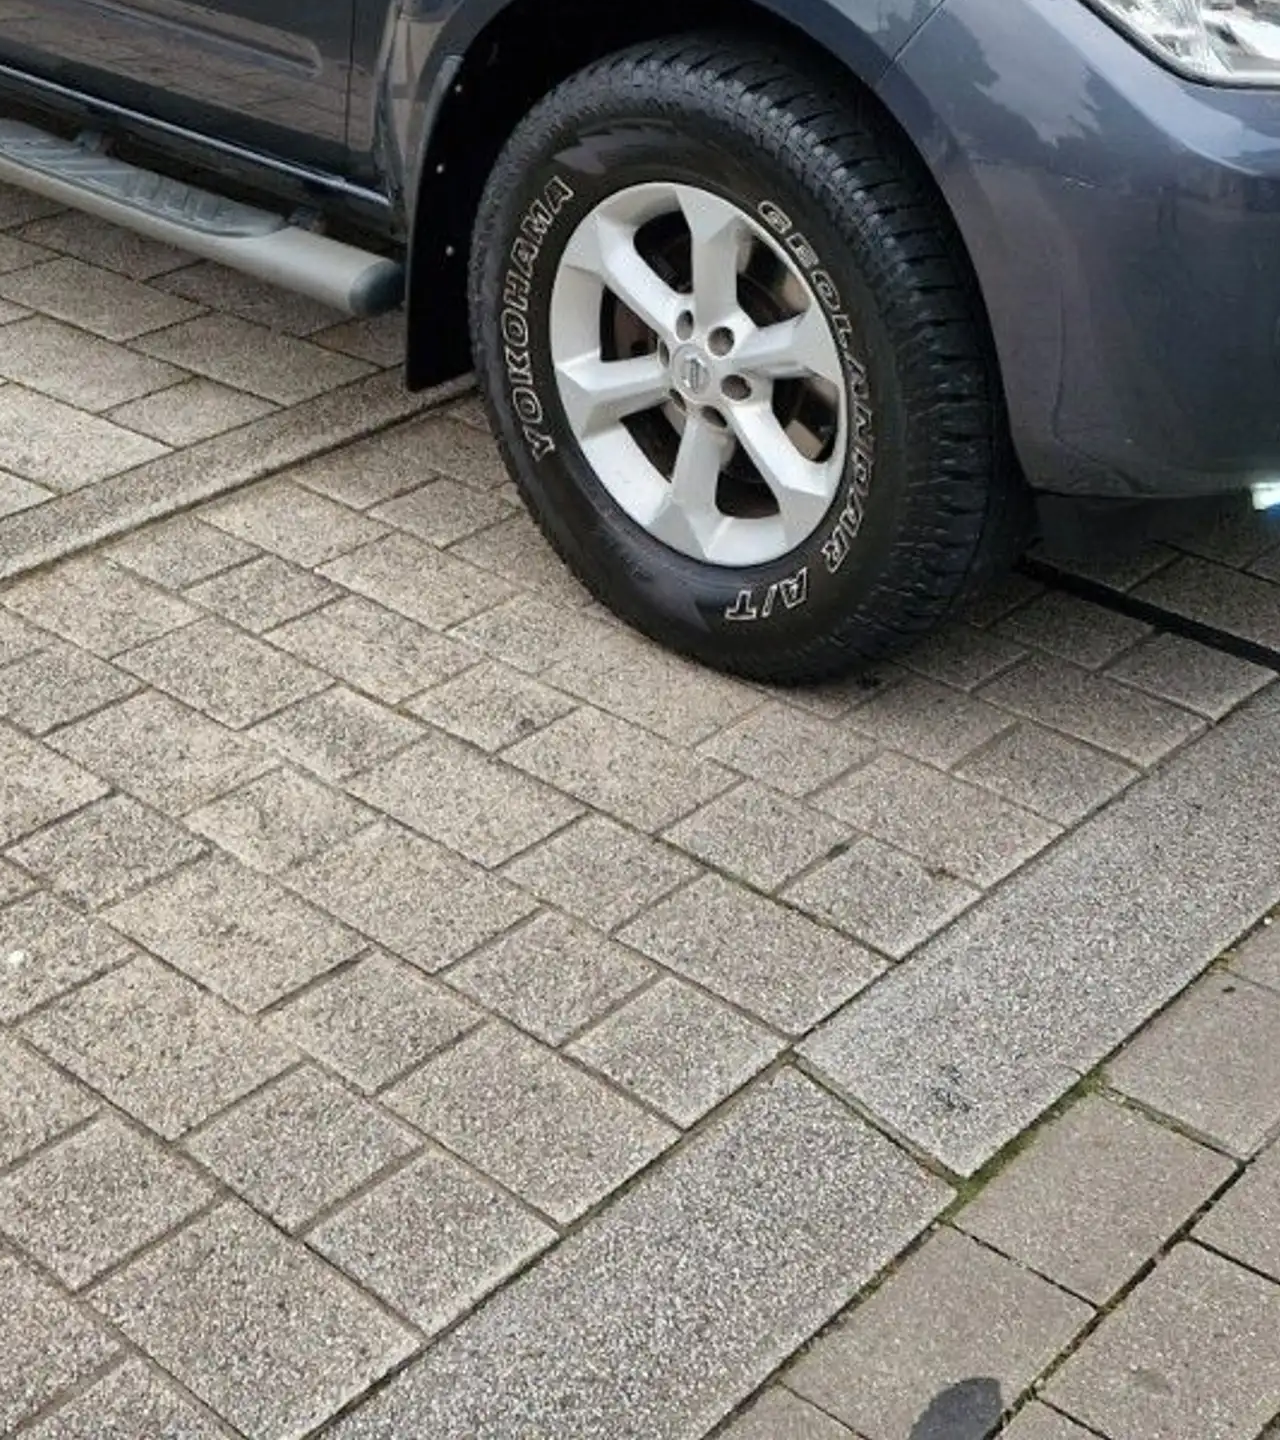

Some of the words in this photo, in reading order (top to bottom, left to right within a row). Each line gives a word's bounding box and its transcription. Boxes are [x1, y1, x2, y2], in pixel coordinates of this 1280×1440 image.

[500, 174, 575, 462] YOKOHAMA
[757, 200, 876, 575] GEOLANDAR
[724, 567, 809, 621] A/T
